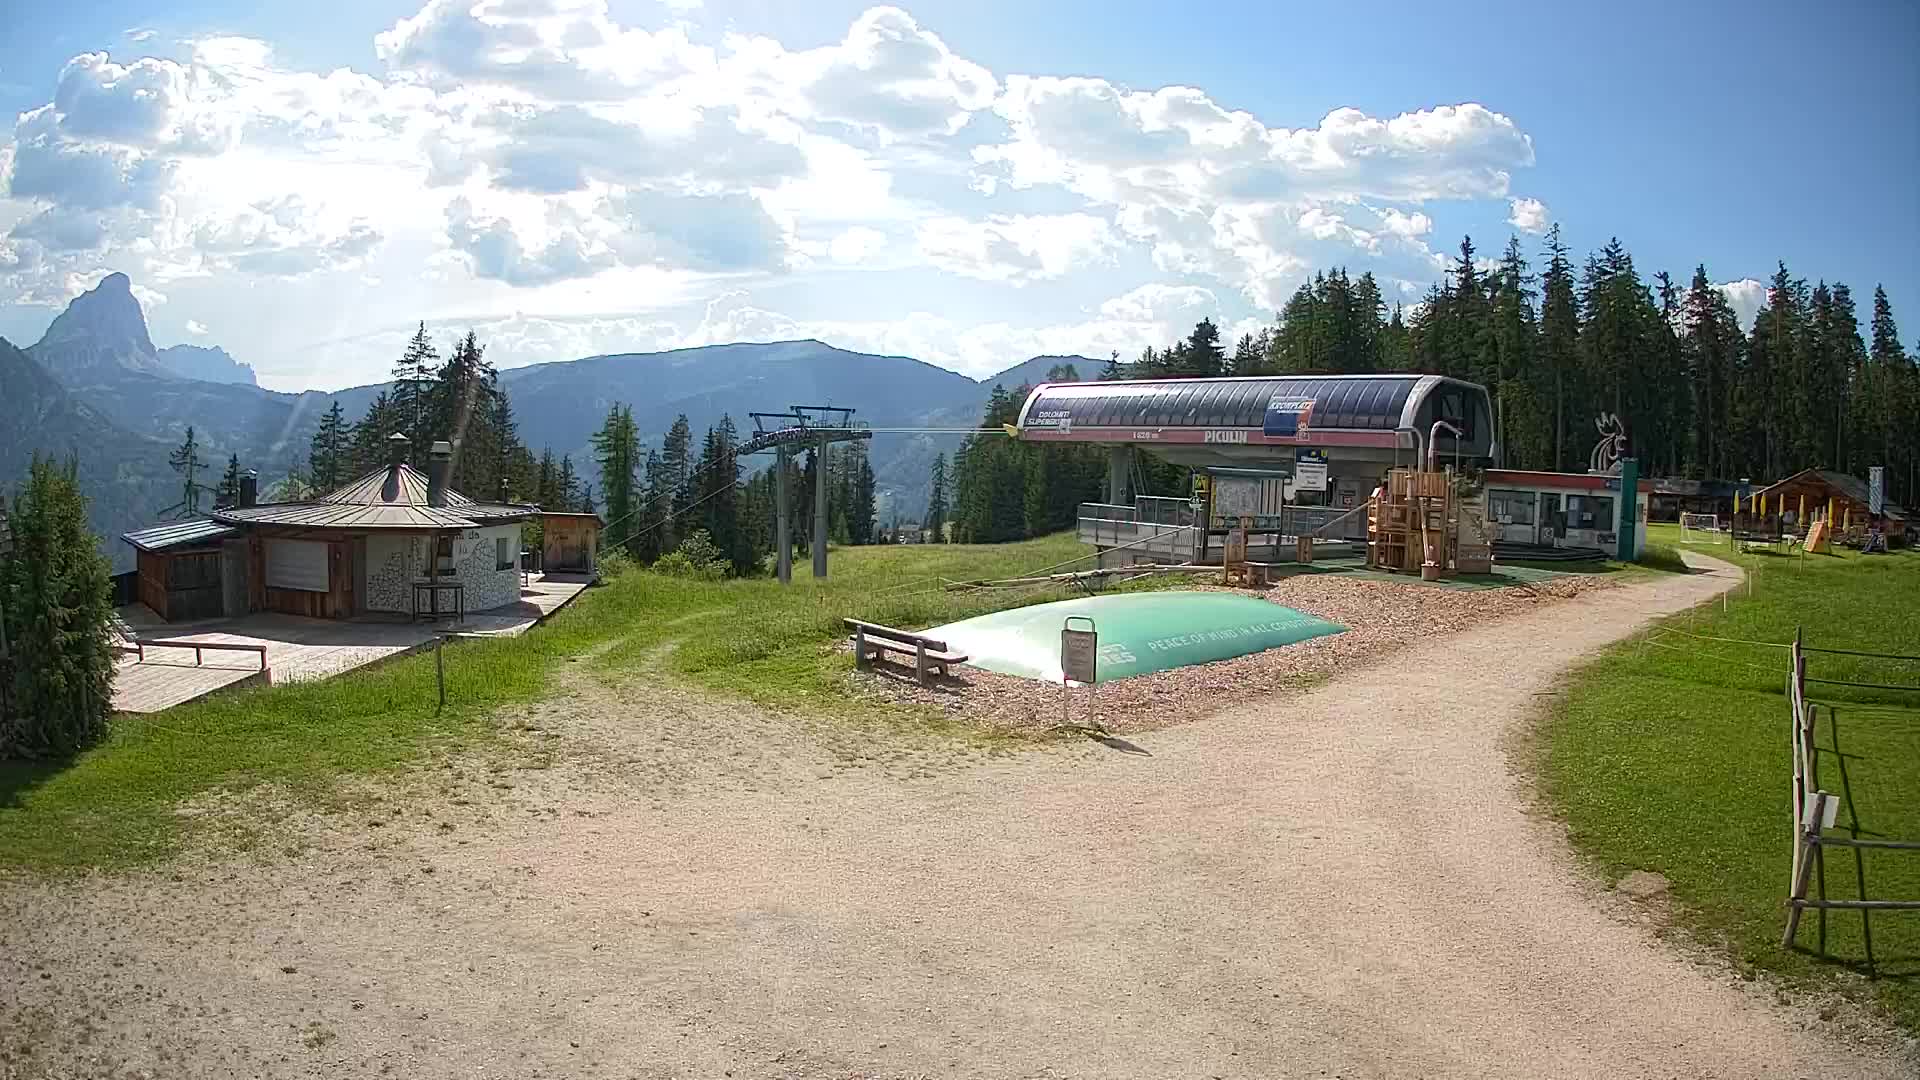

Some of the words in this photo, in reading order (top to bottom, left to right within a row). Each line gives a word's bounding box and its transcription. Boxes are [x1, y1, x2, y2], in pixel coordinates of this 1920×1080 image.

[1203, 431, 1248, 443] PICULIN
[1147, 636, 1191, 650] PEACE
[1190, 632, 1208, 643] OF
[1207, 629, 1238, 641] MIND
[1250, 623, 1271, 633] ALL
